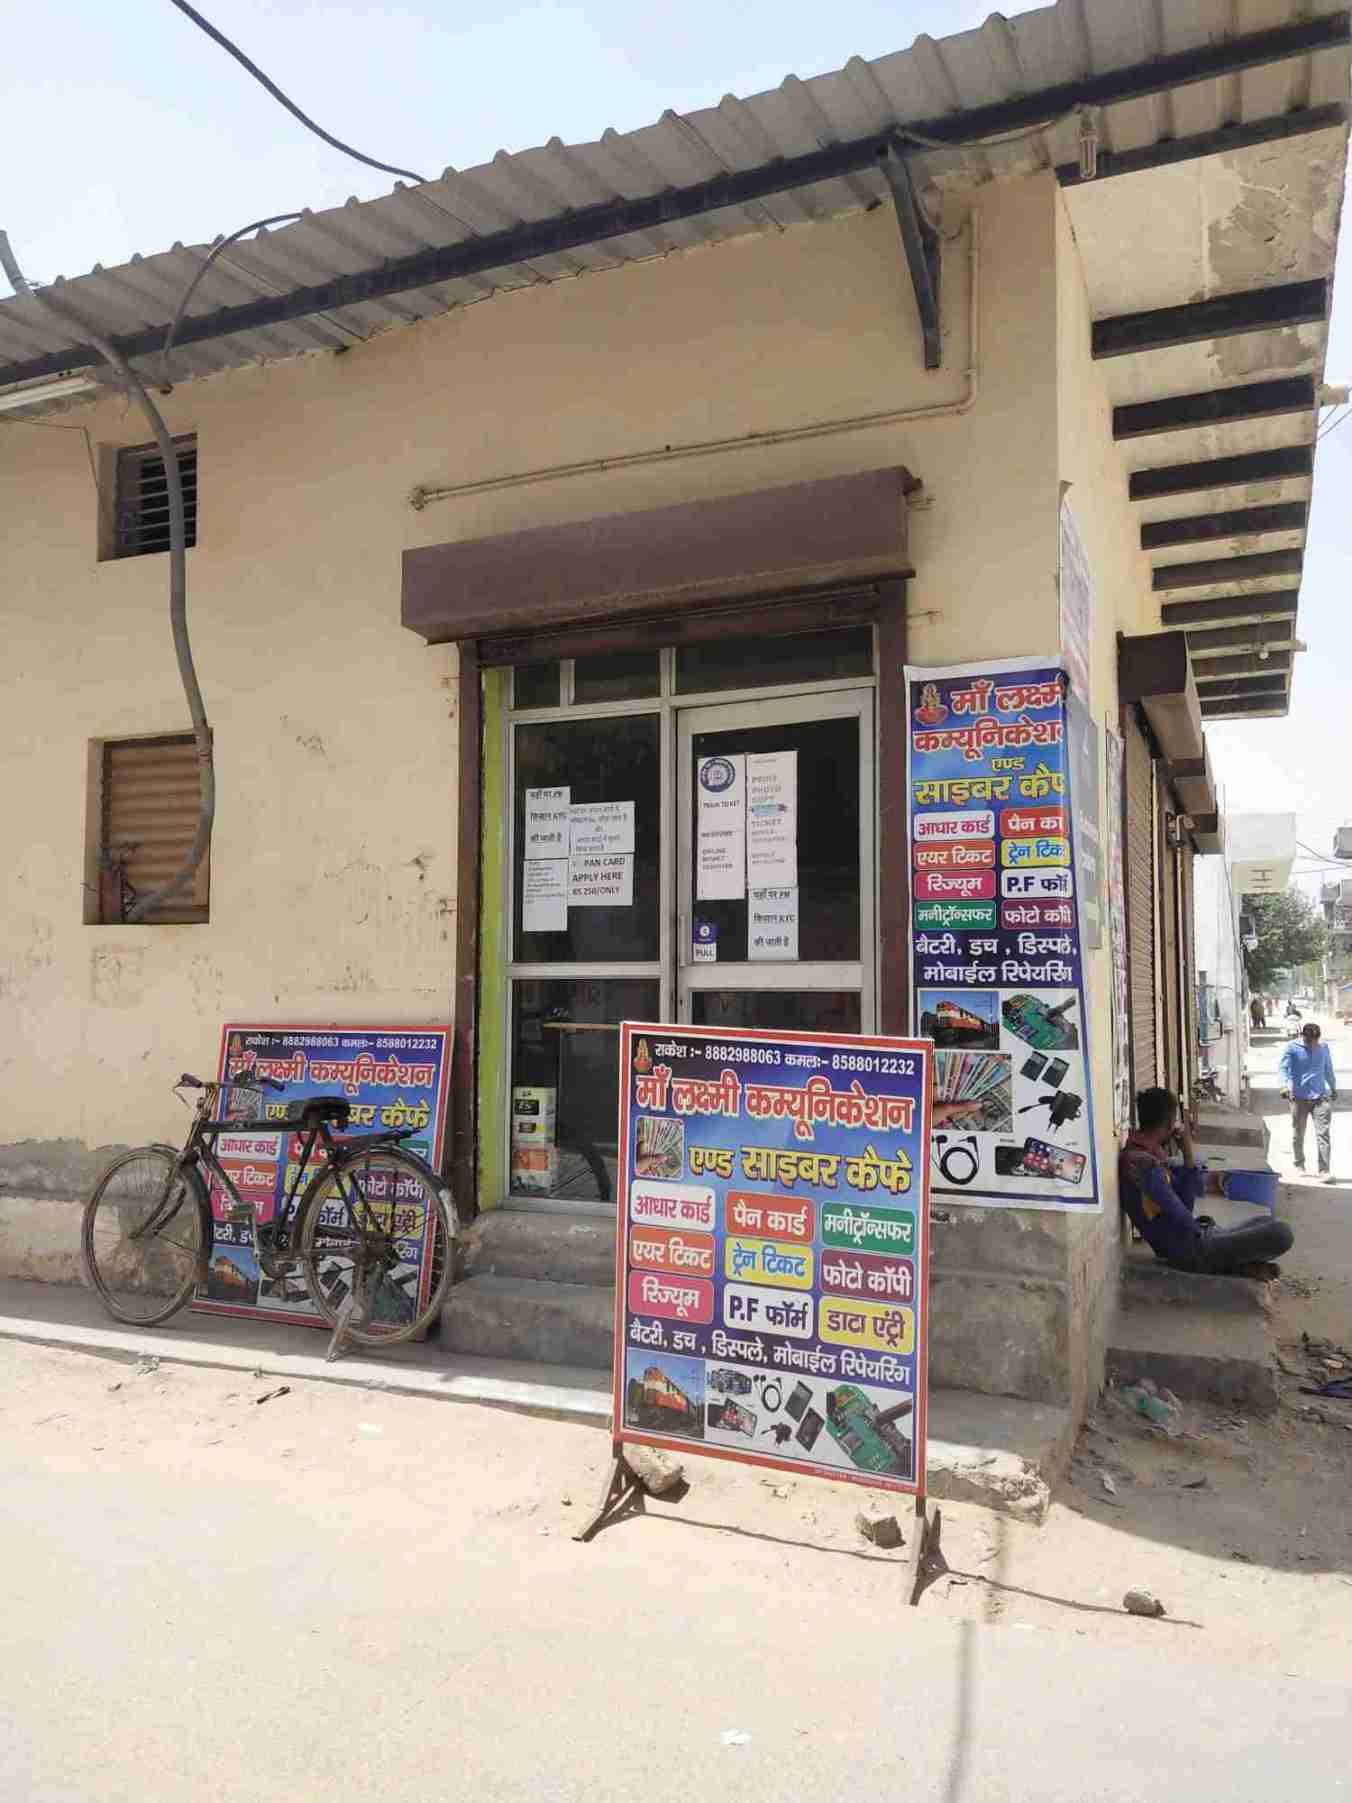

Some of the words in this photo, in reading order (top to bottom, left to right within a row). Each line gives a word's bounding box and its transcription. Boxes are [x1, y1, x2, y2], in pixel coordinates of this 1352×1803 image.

[951, 679, 994, 715] माँ
[912, 776, 1012, 806] साइबर
[918, 822, 958, 837] आधार
[960, 815, 992, 834] कार्ड
[1008, 813, 1034, 832] पैन
[603, 857, 625, 867] CARD
[917, 850, 948, 865] एयर
[952, 845, 993, 865] टिकट
[572, 872, 599, 883] APPLY
[600, 871, 624, 881] HERE
[927, 874, 983, 897] रिज्यूम
[1005, 905, 1041, 924] फोटो
[695, 948, 714, 957] PULL
[923, 961, 997, 984] मोबाईल
[655, 1042, 688, 1058] राकेश
[705, 1045, 782, 1065] 8882988063
[832, 1054, 915, 1075] 8588012232
[308, 1053, 436, 1096] कम्यूनिकेशन
[634, 1063, 672, 1111] माँ
[671, 1068, 741, 1118] लक्ष्मी
[745, 1075, 915, 1141] कम्यूनिकेशन
[688, 1147, 736, 1177] एण्ड
[741, 1147, 841, 1188] साइबर
[635, 1195, 678, 1220] आधार
[680, 1195, 712, 1224] कार्ड
[732, 1199, 762, 1230] पैन
[767, 1206, 809, 1236] कार्ड
[633, 1239, 665, 1264] एयर
[667, 1236, 712, 1270] टिकट
[732, 1243, 757, 1277] ट्रेन
[761, 1244, 807, 1277] टिकट
[823, 1262, 863, 1291] फोटो
[867, 1266, 912, 1297] कॉपी
[641, 1276, 700, 1317] रिज्यूम
[729, 1294, 759, 1321] P.F
[765, 1300, 809, 1331] फॉर्म
[827, 1309, 866, 1332] डाटा
[773, 1344, 836, 1374] मोबाईल
[840, 1350, 911, 1385] रिपेयरिंग
